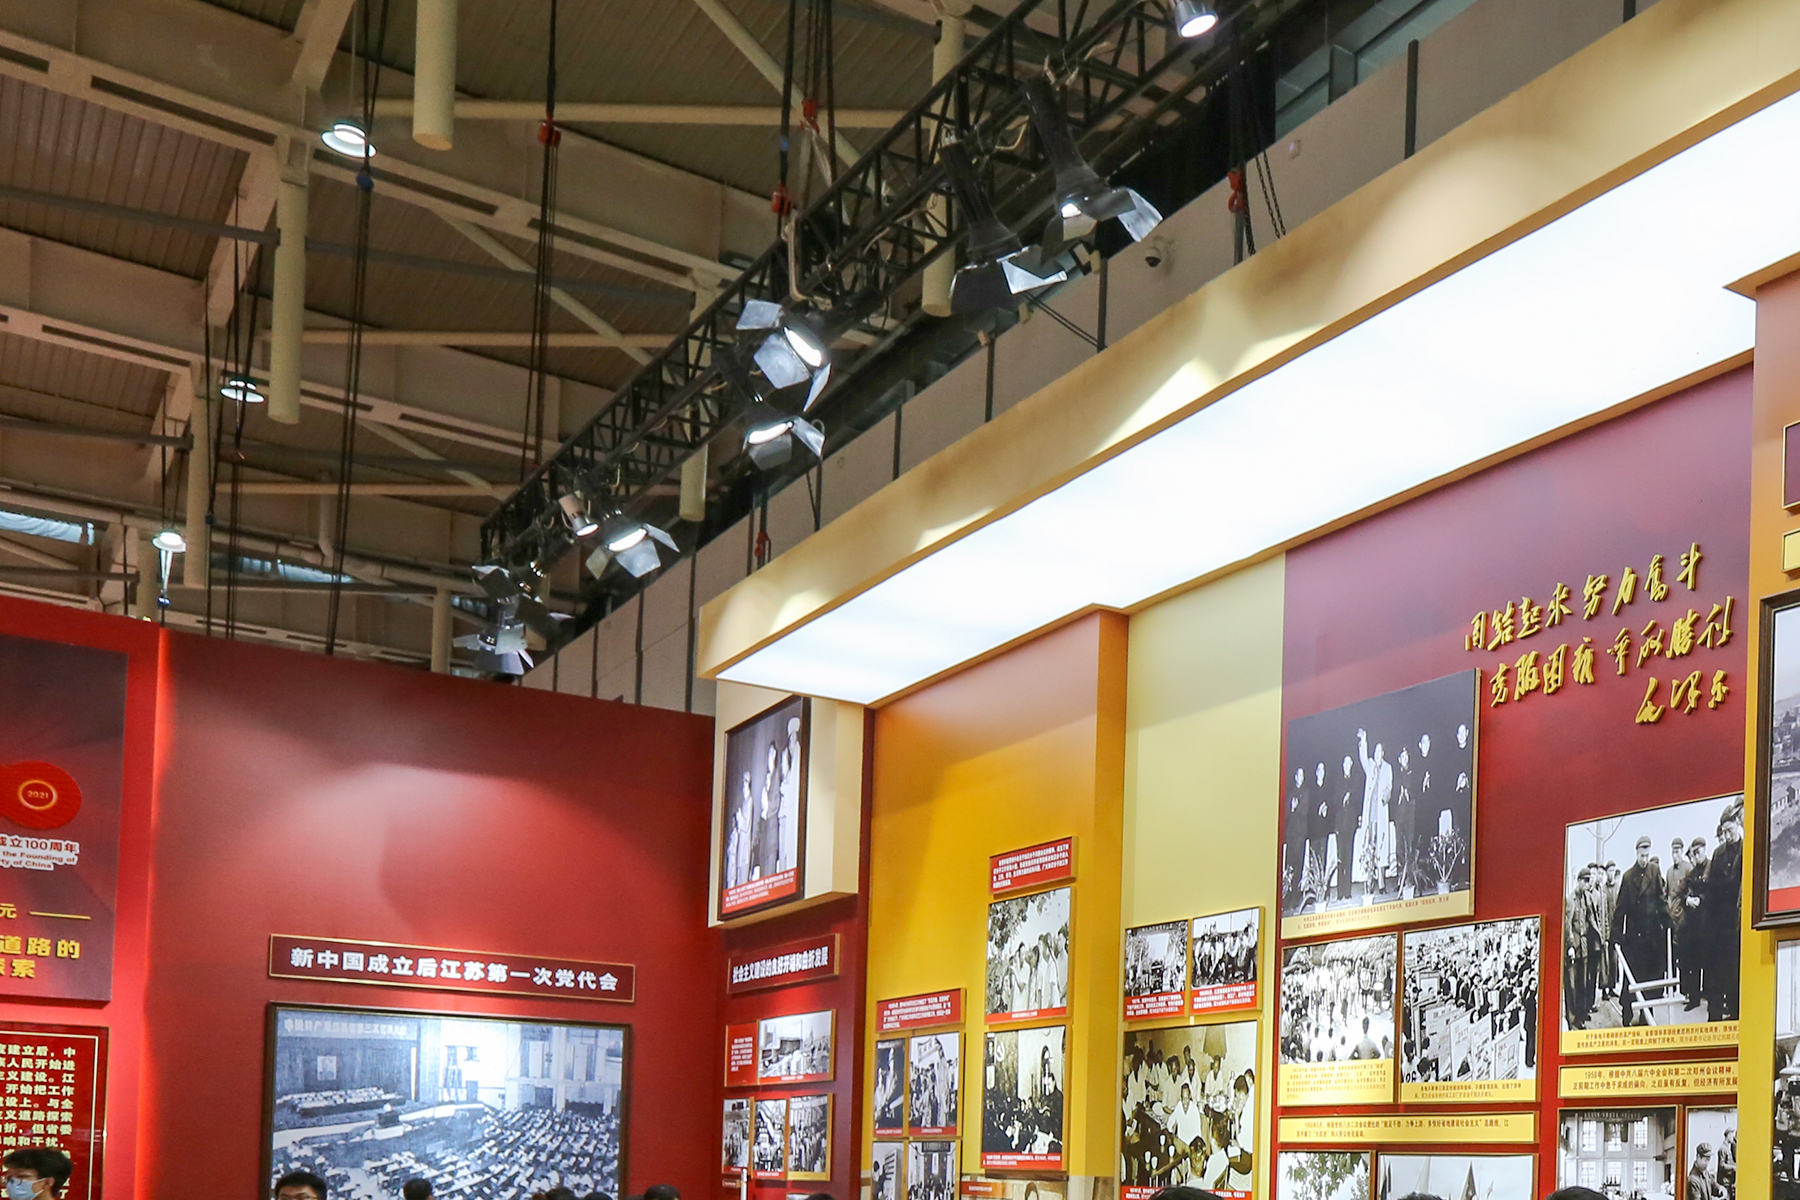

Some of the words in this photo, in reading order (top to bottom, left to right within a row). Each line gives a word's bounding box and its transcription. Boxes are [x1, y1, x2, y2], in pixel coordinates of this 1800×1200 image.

[27, 790, 49, 799] 2021
[20, 852, 63, 863] Founding
[0, 935, 80, 959] 道路的
[0, 958, 36, 978] 索
[290, 947, 619, 992] 新中国成立后江苏第一次党代会
[6, 1083, 74, 1097] 开始把工作
[0, 1096, 73, 1110] 设上。与全
[0, 1110, 73, 1122] 义道路探索
[0, 1123, 72, 1136] 折，但省委
[0, 1136, 65, 1148] 响和干扰，
